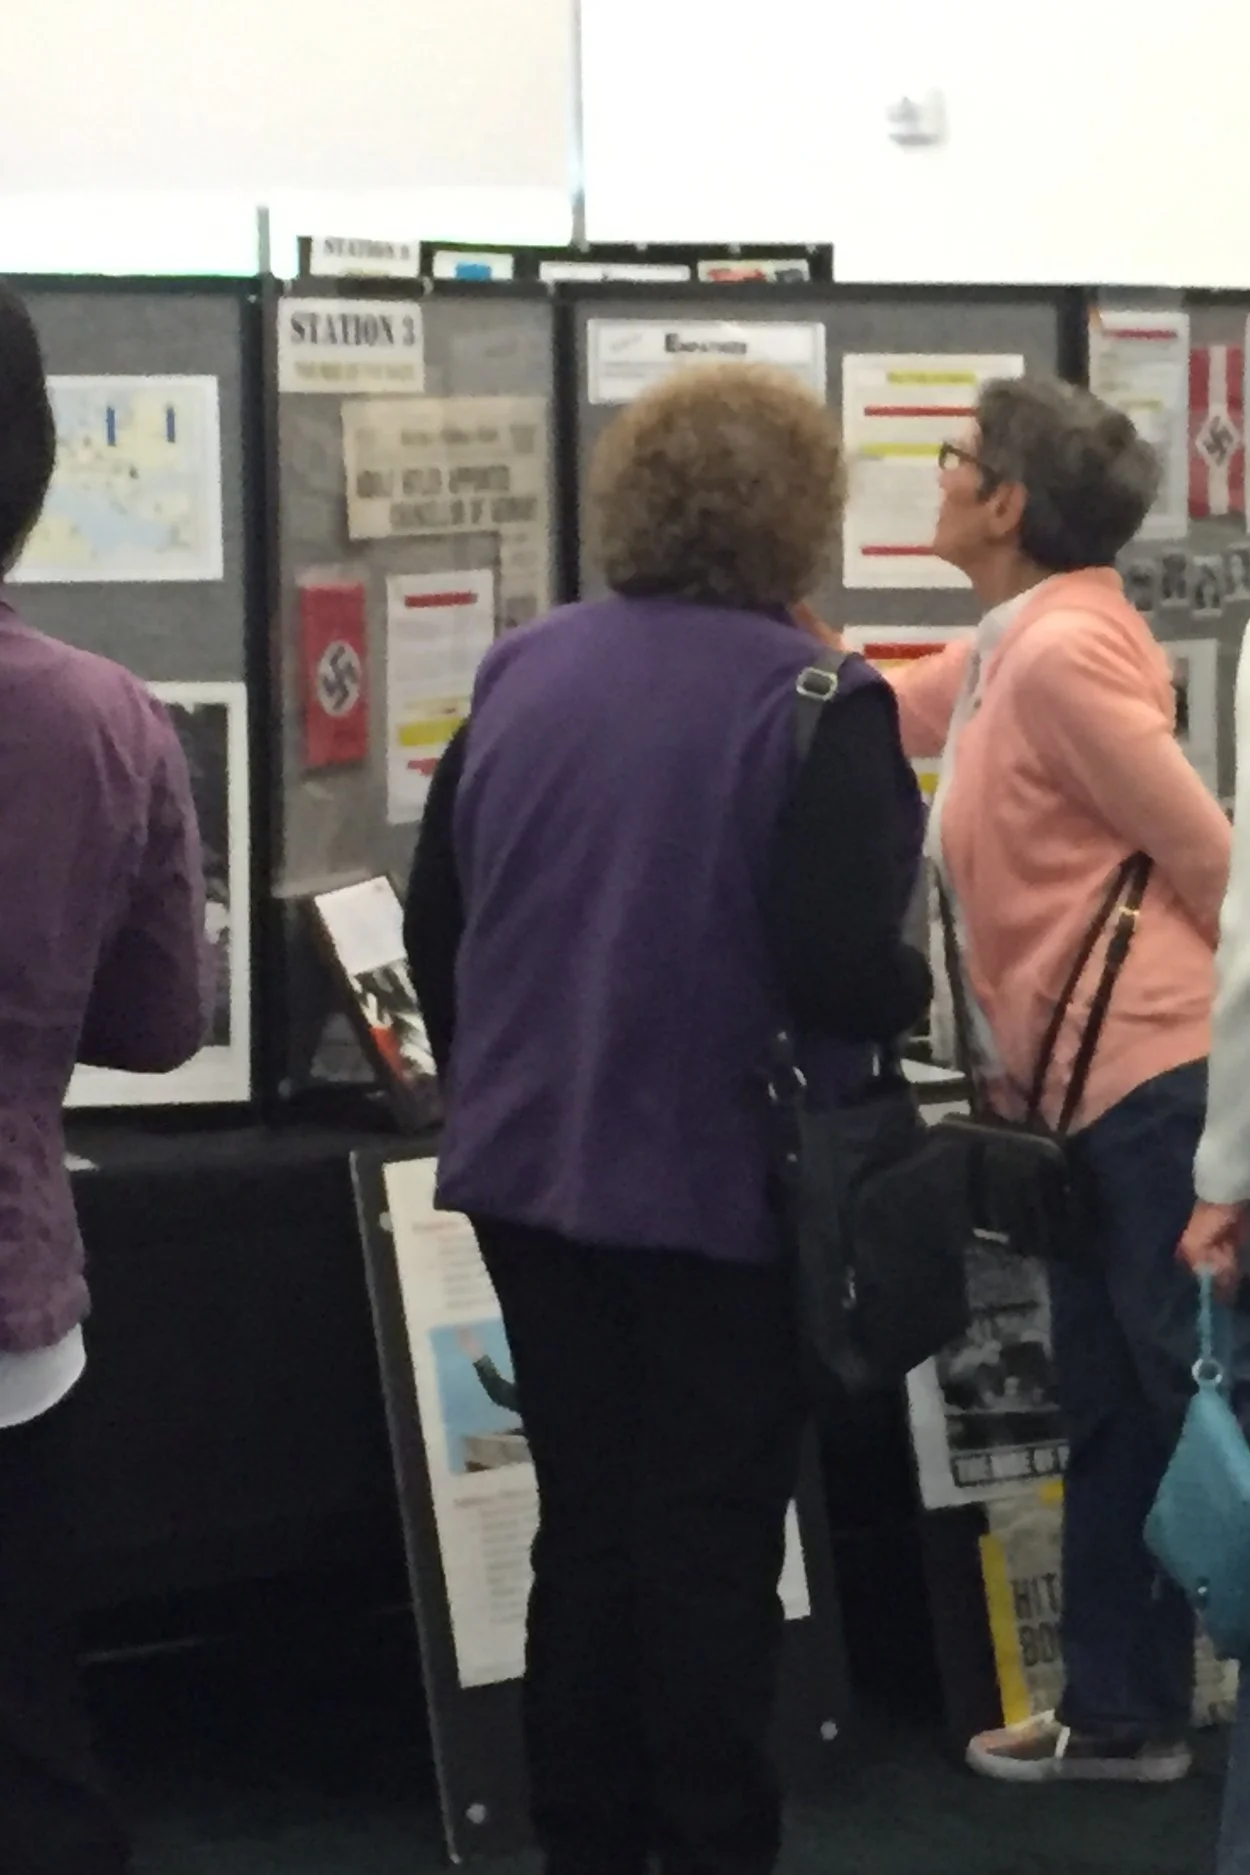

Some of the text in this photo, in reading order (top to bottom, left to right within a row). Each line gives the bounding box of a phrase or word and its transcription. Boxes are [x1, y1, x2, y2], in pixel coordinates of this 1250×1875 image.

[290, 312, 415, 346] STATION 3
[1010, 1572, 1062, 1621] HIT
[1018, 1620, 1062, 1667] BO
